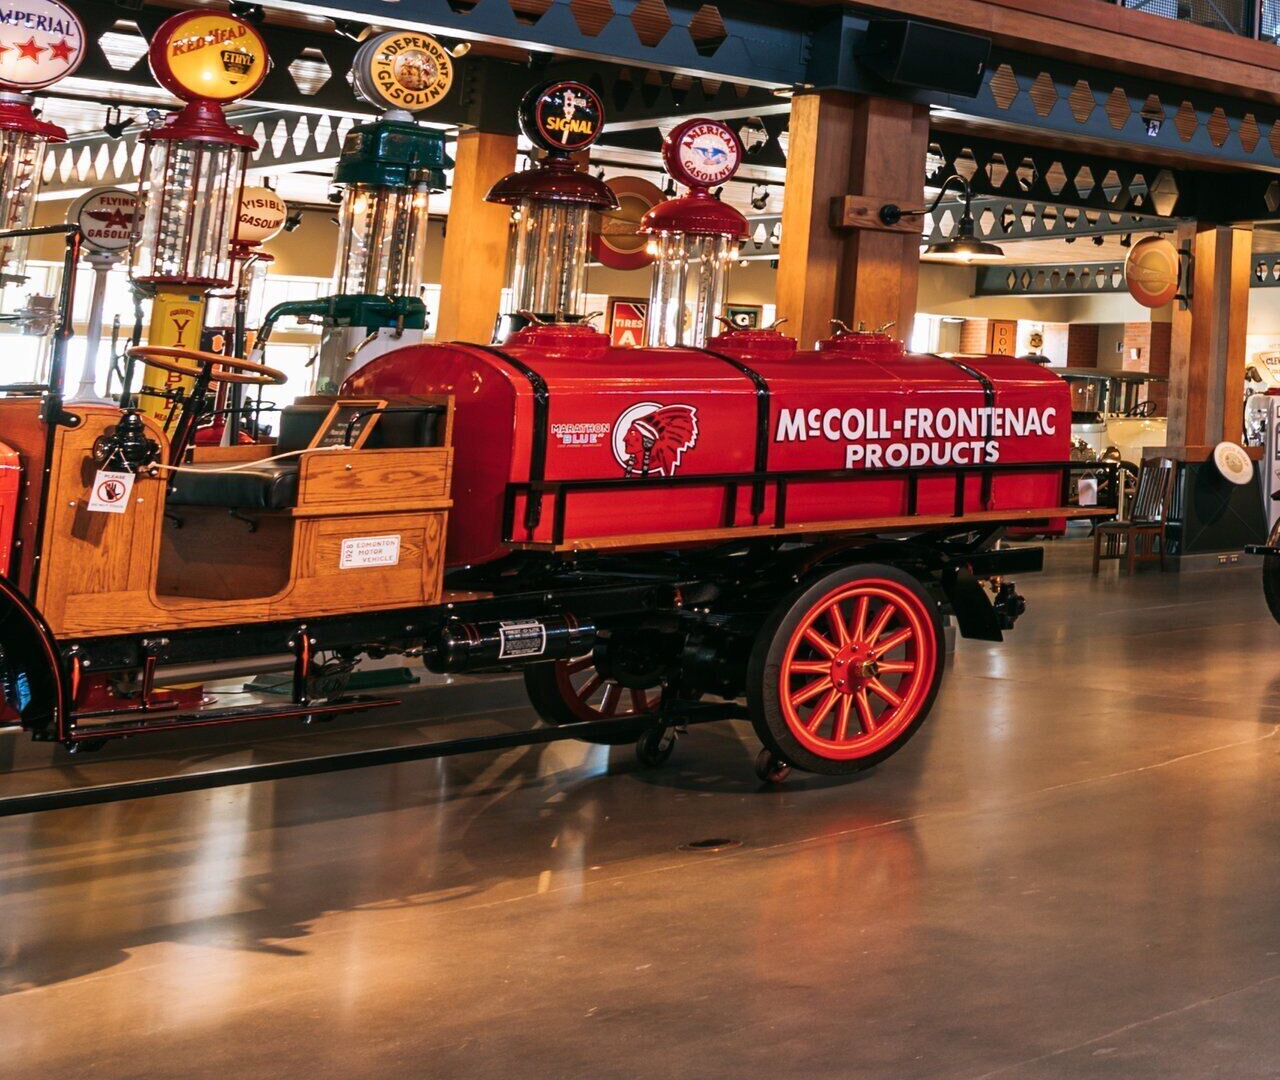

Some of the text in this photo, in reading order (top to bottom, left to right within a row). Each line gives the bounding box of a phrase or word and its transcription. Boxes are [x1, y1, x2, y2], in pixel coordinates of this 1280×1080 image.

[223, 52, 252, 65] ETHYL
[377, 70, 447, 105] GASOLINE
[546, 116, 593, 135] SIGNAL
[682, 124, 736, 154] AMERICAN
[684, 160, 732, 182] GASOLINE
[239, 213, 284, 229] GASOLIN
[614, 318, 644, 329] TIRES
[551, 422, 611, 434] MARATHON
[844, 439, 1000, 469] PRODUCTS
[356, 539, 396, 549] EDMONTON
[358, 548, 383, 556] MOTOR
[344, 543, 354, 562] 1928
[362, 555, 393, 563] VEHICLE
